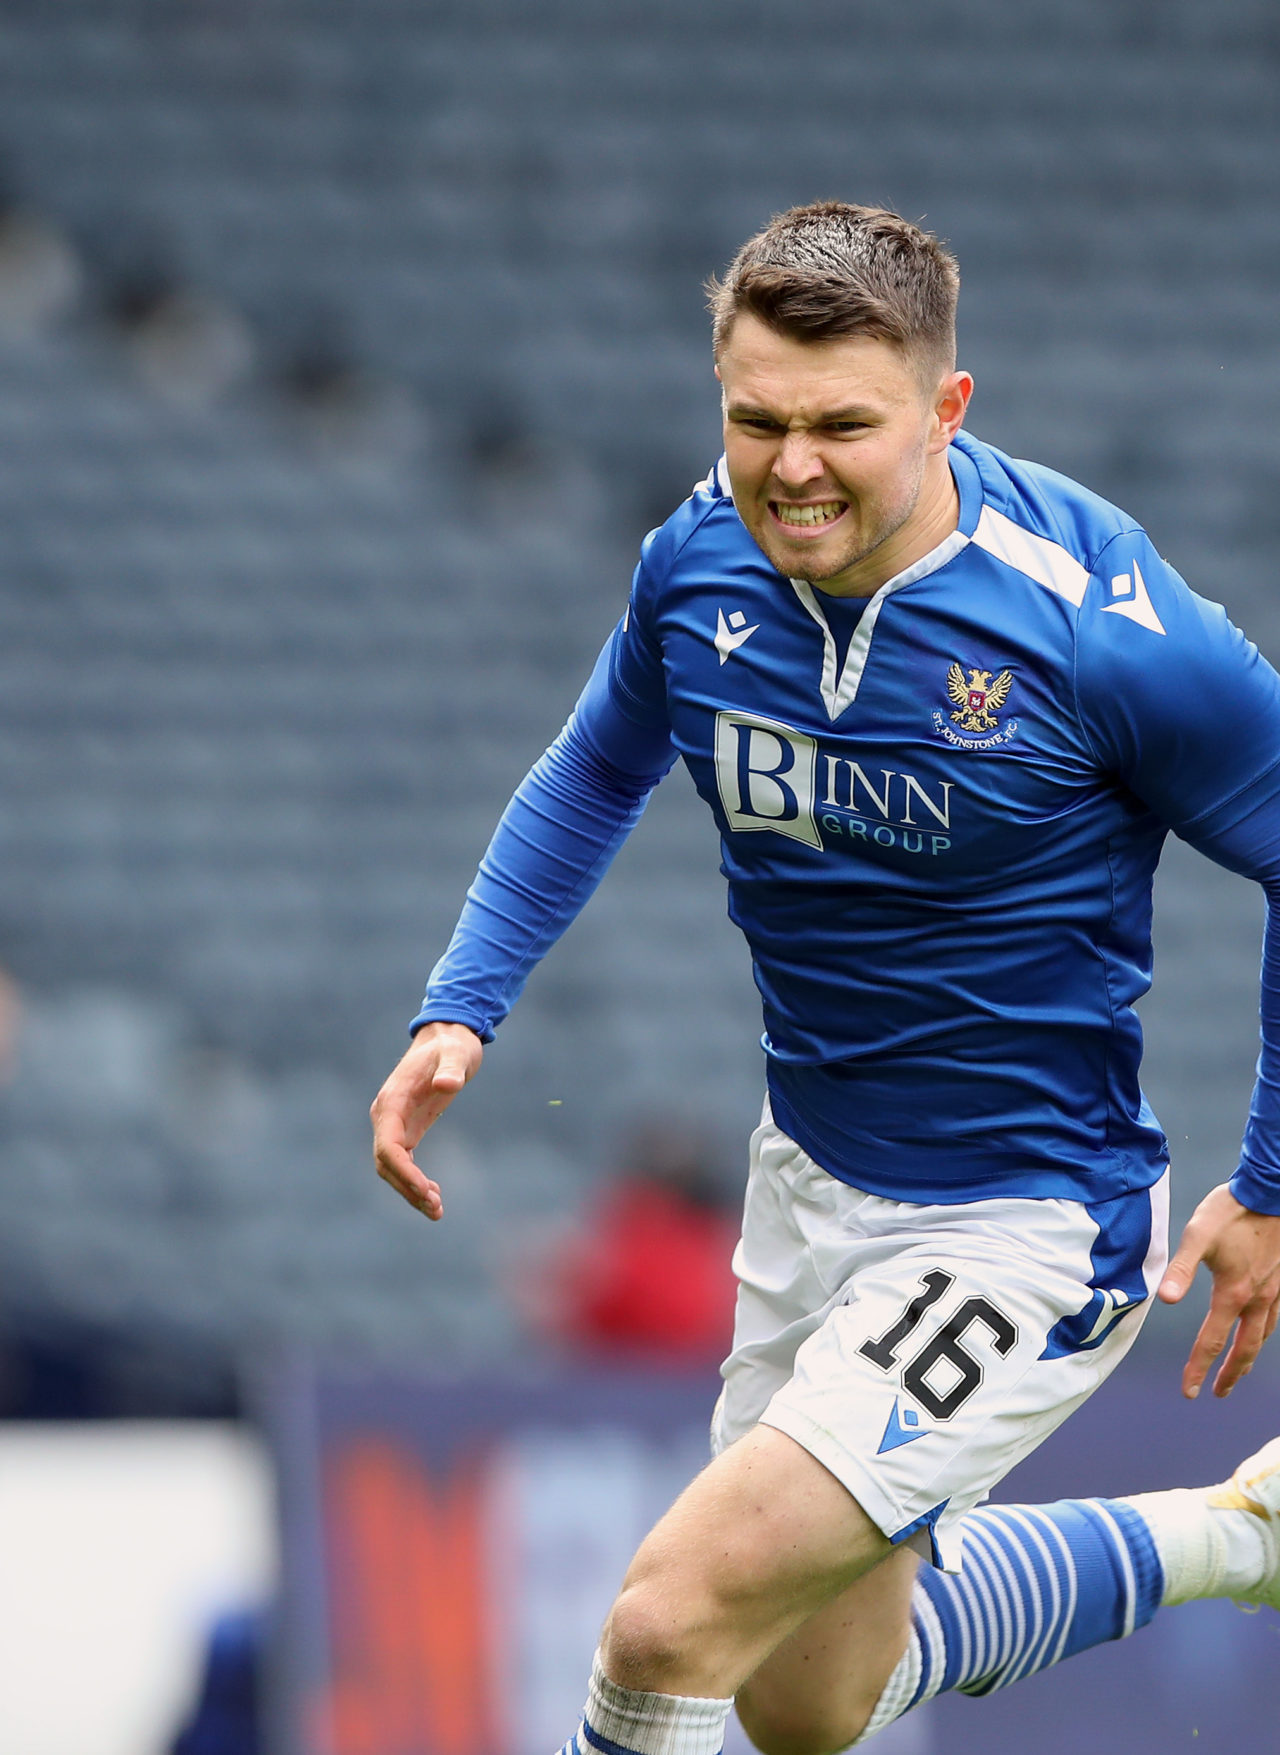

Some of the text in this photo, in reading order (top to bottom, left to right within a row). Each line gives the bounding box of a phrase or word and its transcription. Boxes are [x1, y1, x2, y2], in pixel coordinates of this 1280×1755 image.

[940, 726, 1004, 750] JOHNSTONE
[729, 723, 955, 829] BINN
[821, 814, 953, 857] GROUP
[854, 1266, 1019, 1423] 16
